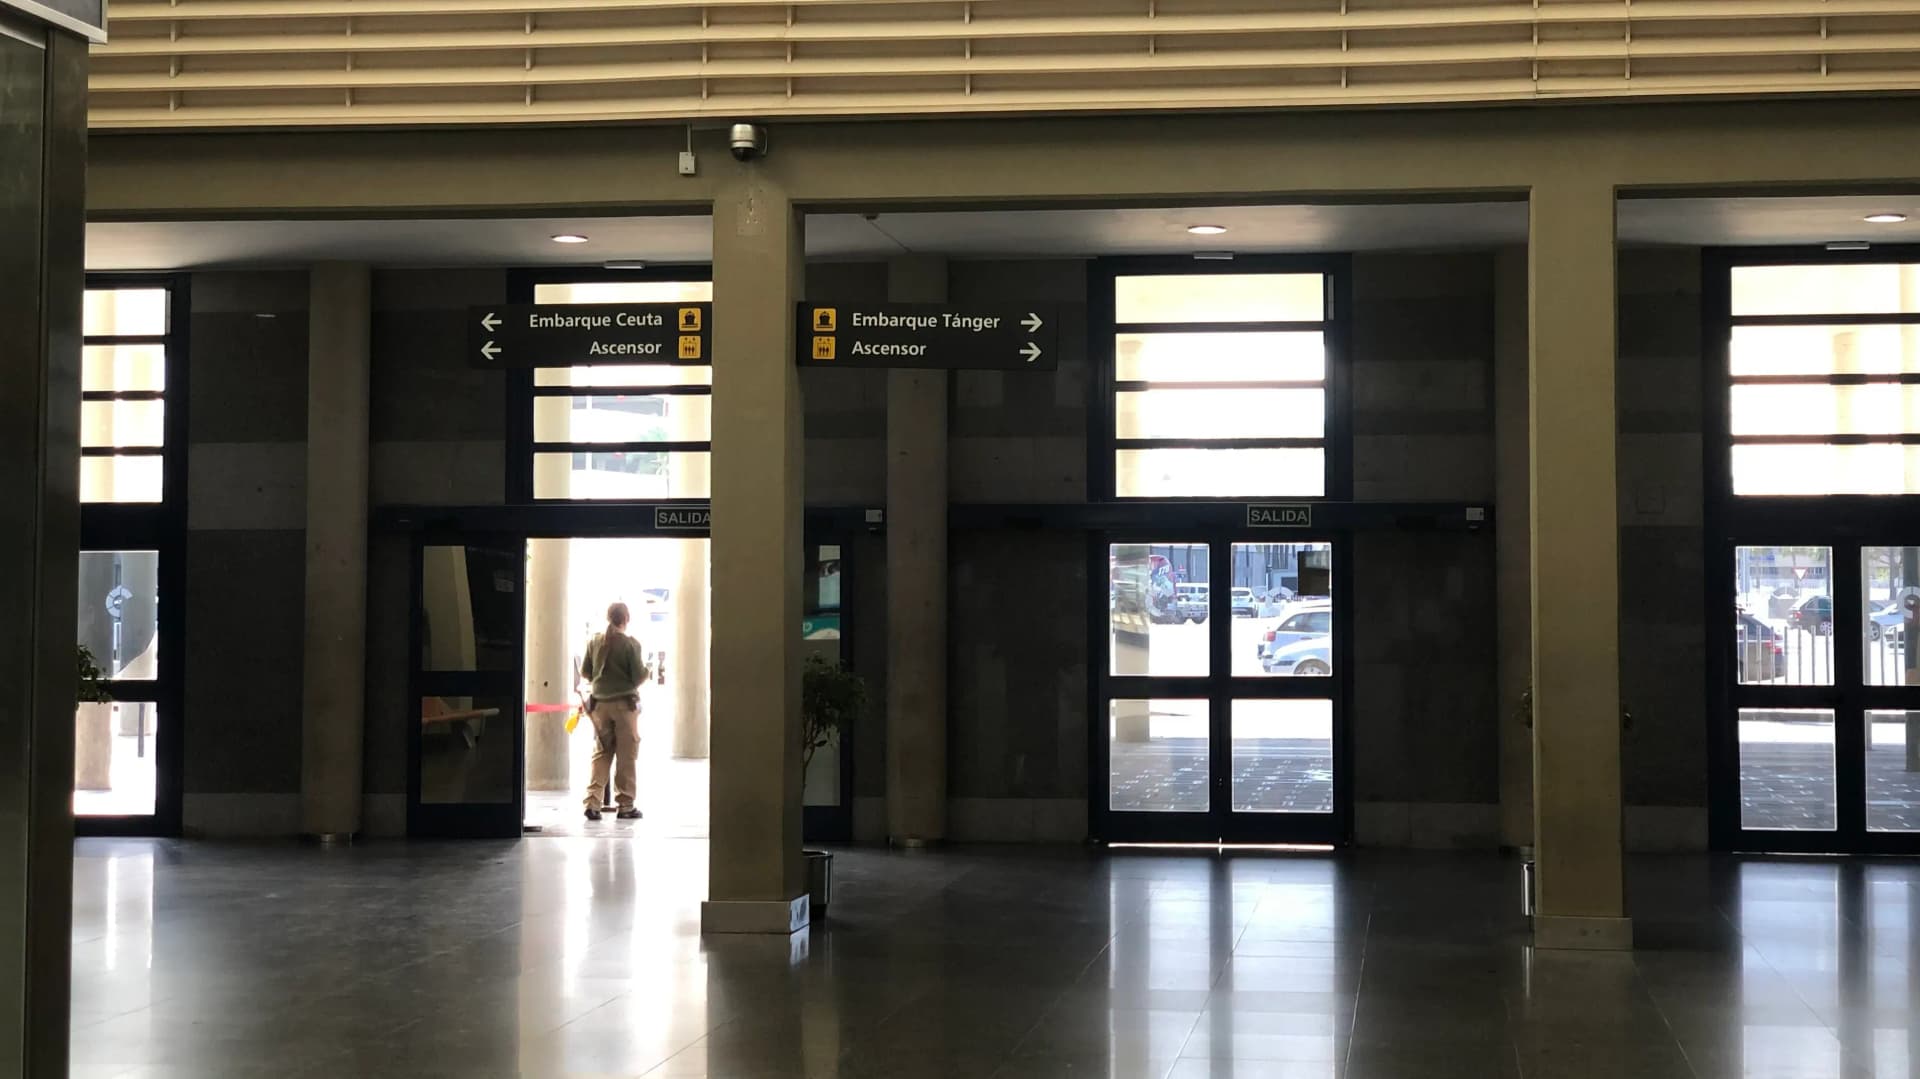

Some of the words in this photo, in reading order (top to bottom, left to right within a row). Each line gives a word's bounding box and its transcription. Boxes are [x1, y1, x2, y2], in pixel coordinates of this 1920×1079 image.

[529, 313, 611, 331] Embarque
[617, 312, 663, 327] Ceuta
[852, 311, 937, 331] Embarque
[942, 312, 1001, 332] Tánger
[589, 341, 662, 355] Ascensor
[851, 340, 927, 356] Ascensor
[1250, 509, 1308, 522] SALIDA
